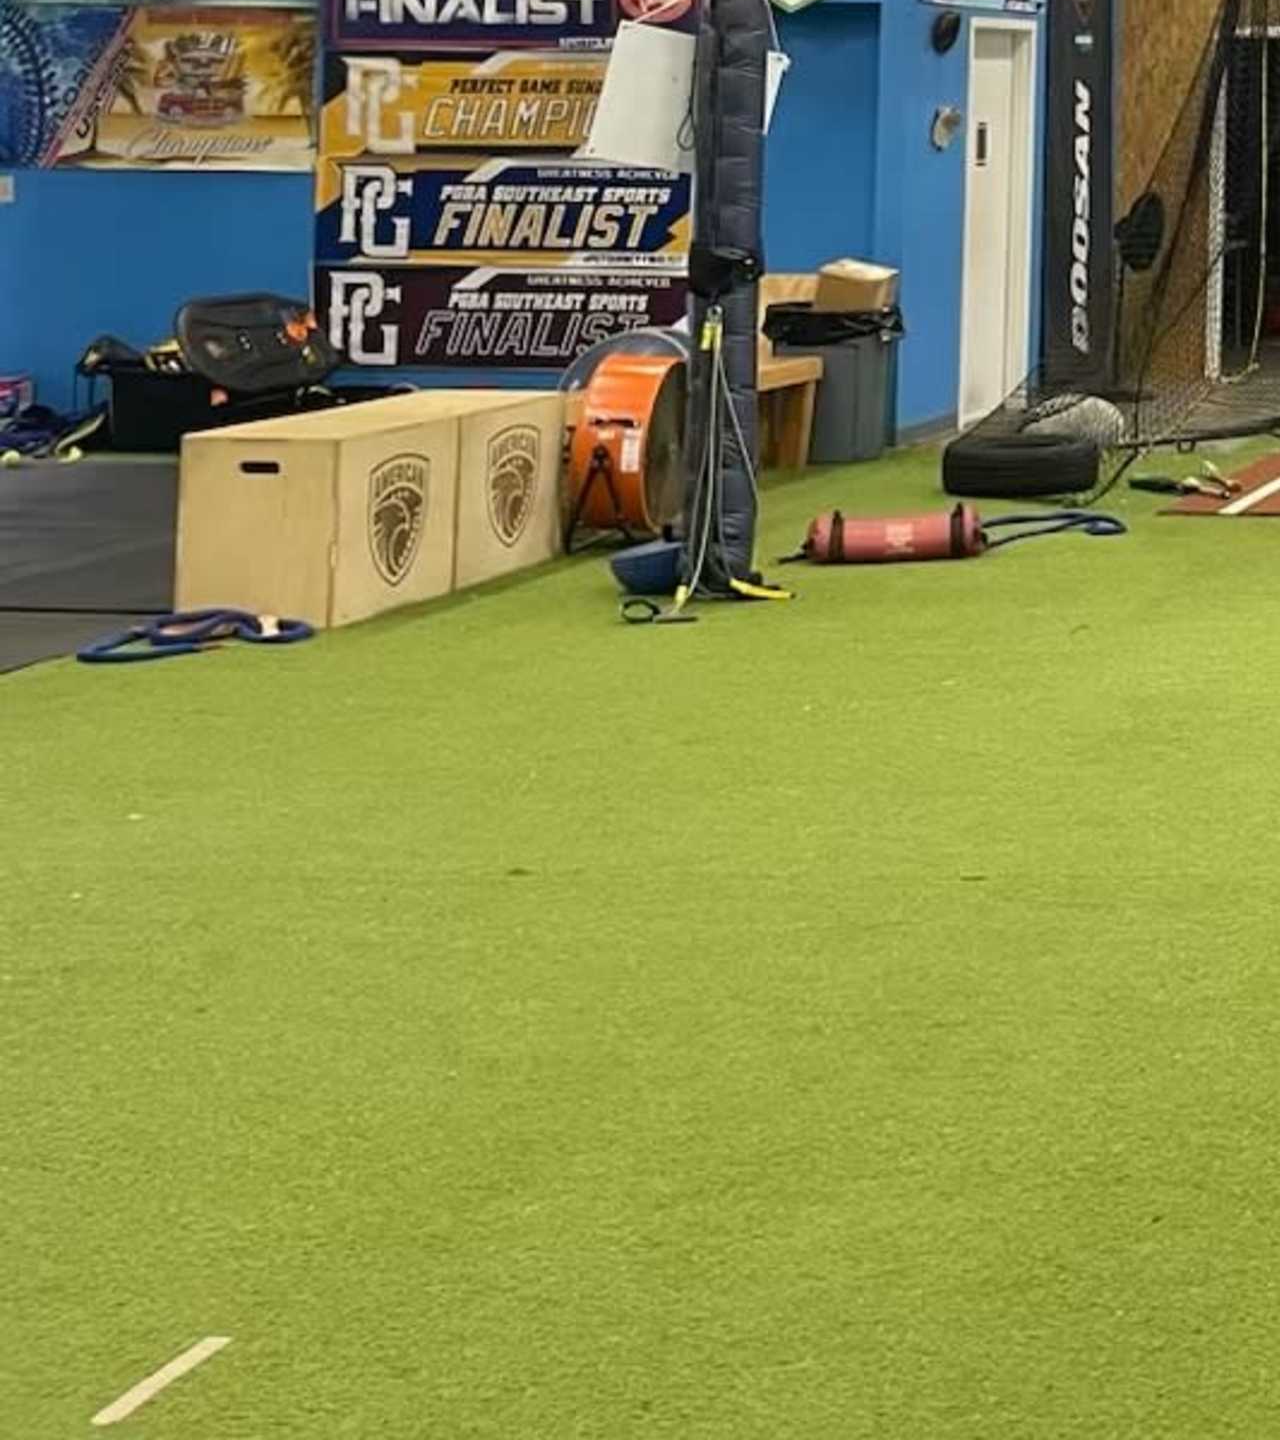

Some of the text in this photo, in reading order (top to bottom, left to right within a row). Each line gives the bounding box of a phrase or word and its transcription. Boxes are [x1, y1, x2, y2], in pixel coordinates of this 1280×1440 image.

[342, 56, 418, 154] PG
[340, 165, 412, 257] PG
[433, 203, 658, 248] FINALIST
[601, 187, 671, 205] SPORTS
[1070, 79, 1090, 353] DOOSAN
[328, 270, 401, 366] PG
[588, 293, 648, 311] SPORTS
